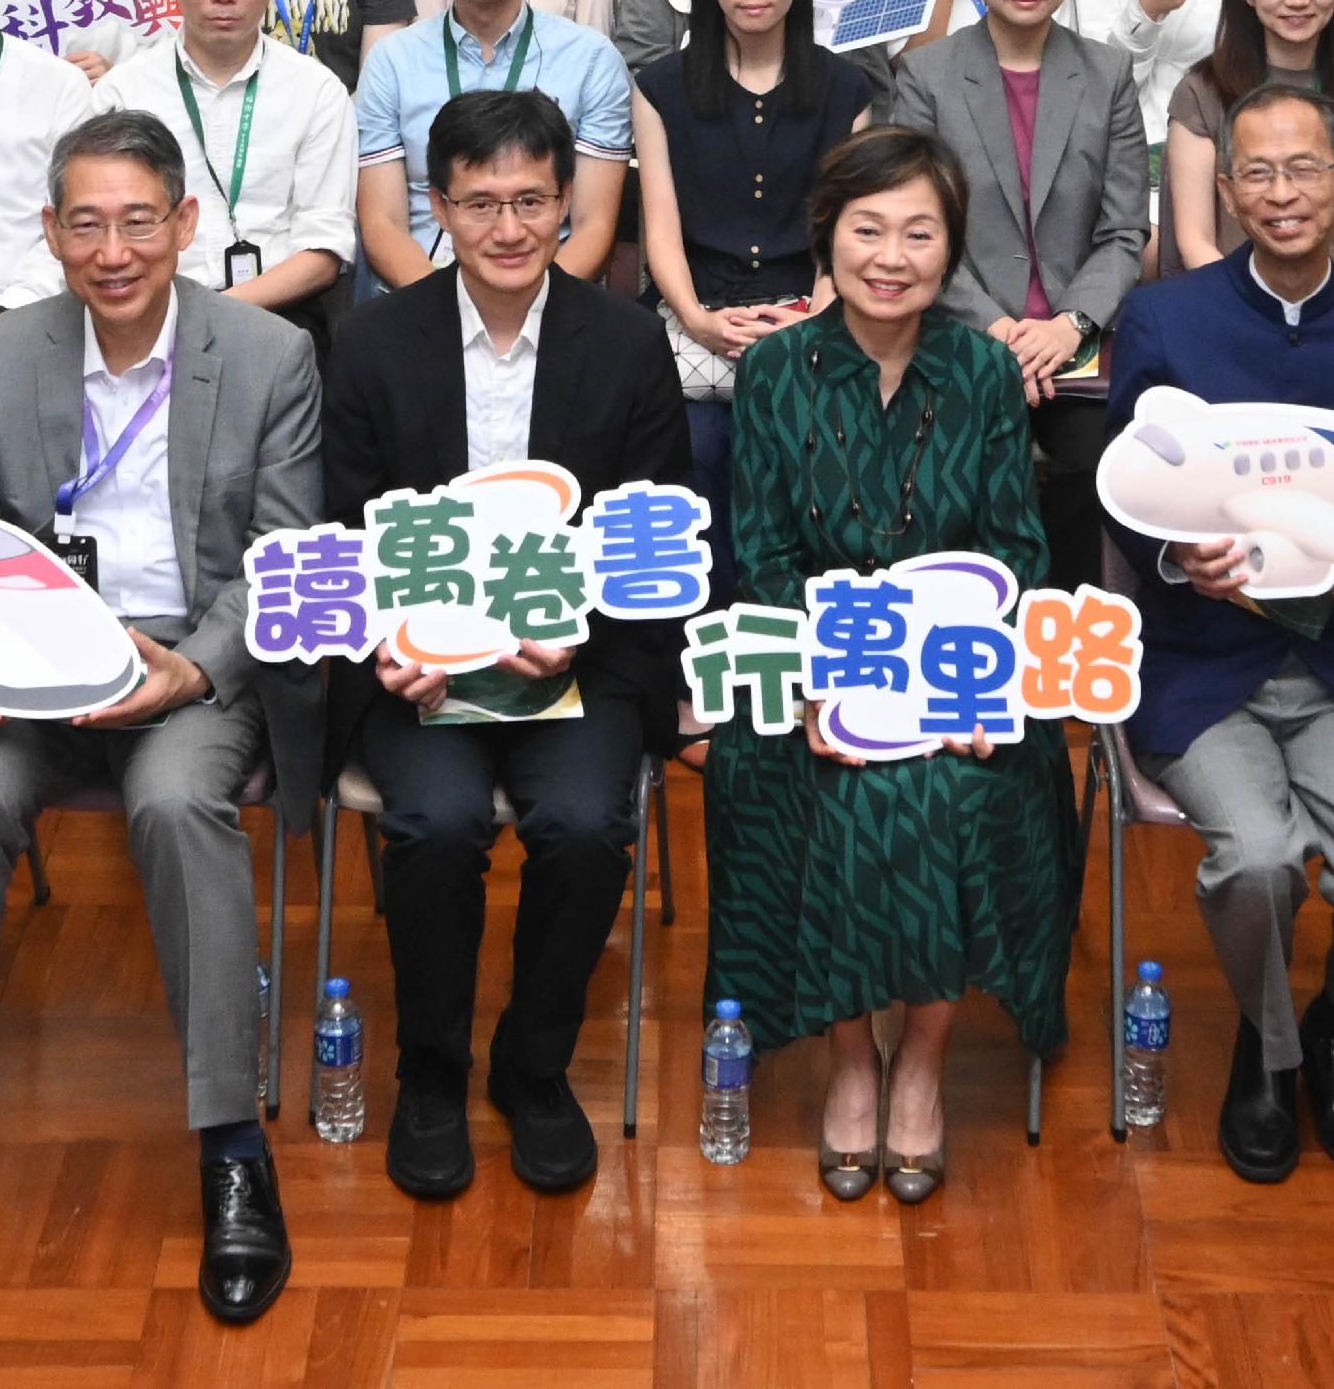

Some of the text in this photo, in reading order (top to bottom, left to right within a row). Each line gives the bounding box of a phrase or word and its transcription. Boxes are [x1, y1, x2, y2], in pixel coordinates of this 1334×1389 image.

[1261, 474, 1292, 486] C919
[250, 488, 707, 654] 讀萬卷書
[690, 580, 1138, 734] 行萬里路
